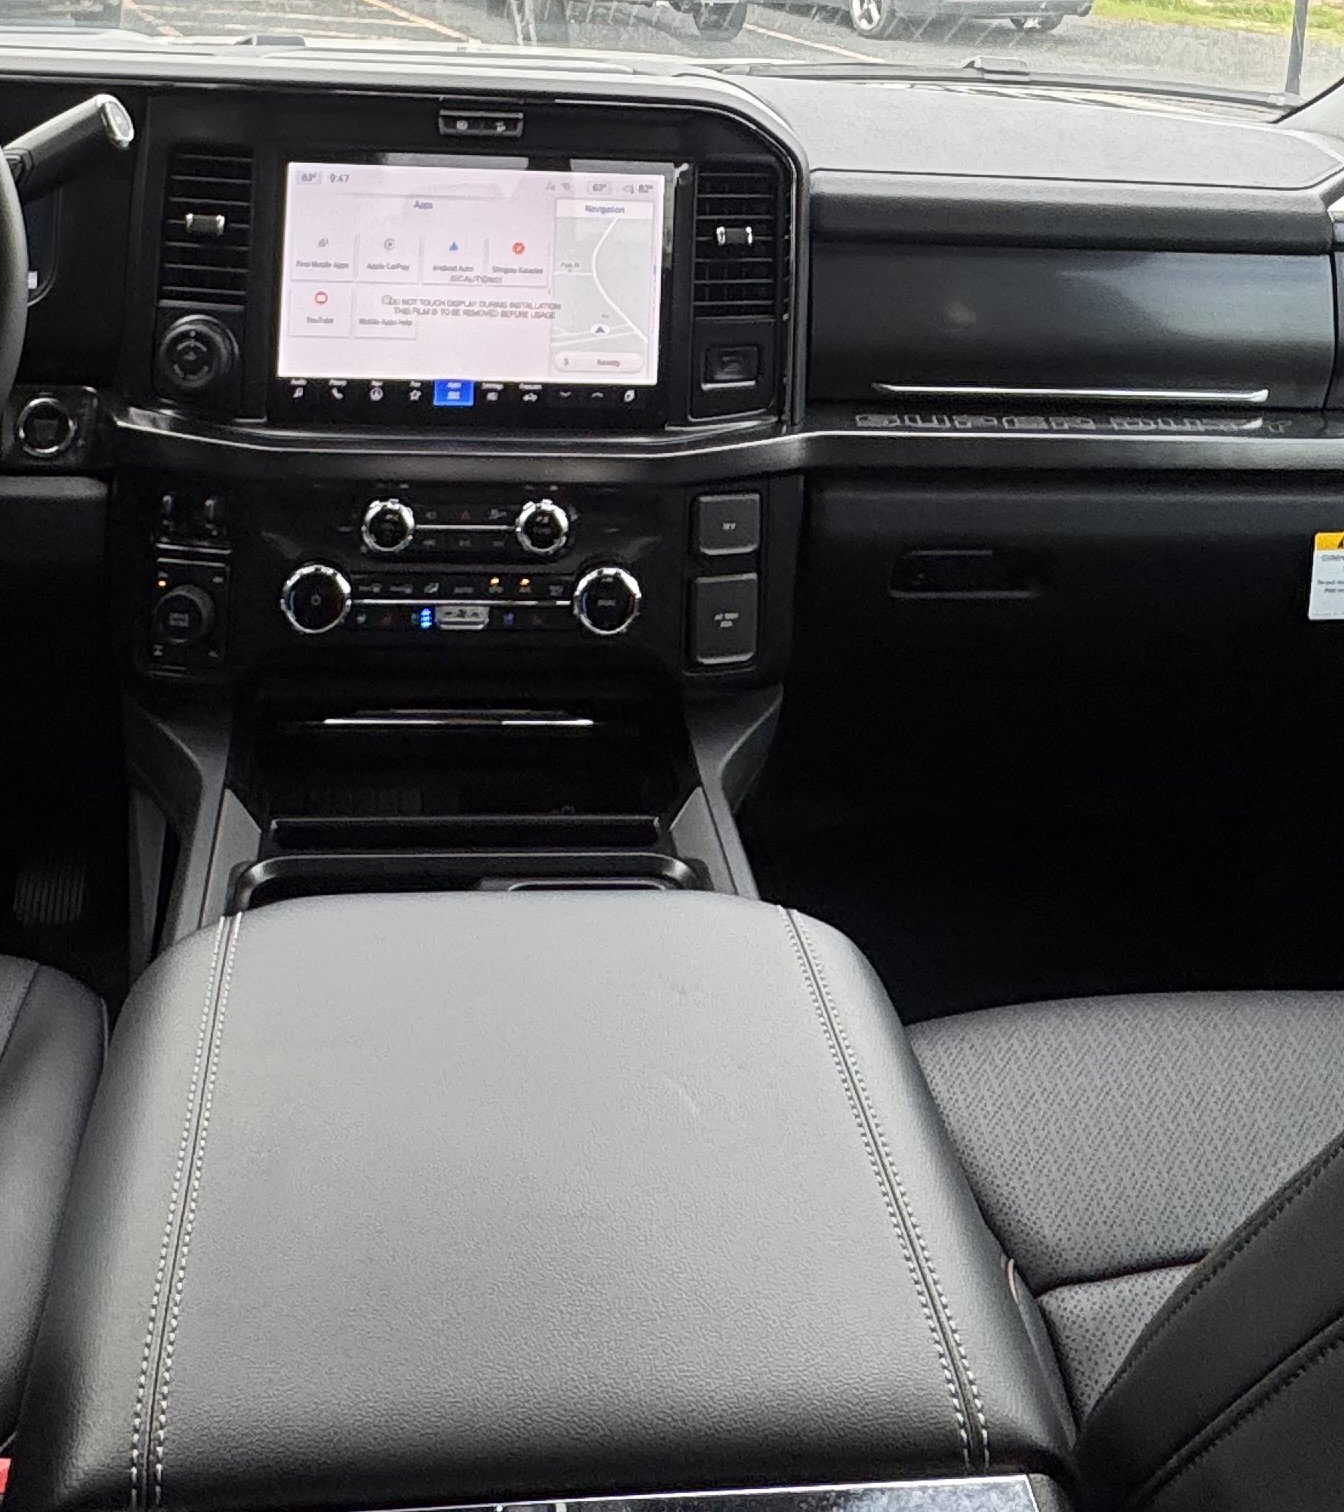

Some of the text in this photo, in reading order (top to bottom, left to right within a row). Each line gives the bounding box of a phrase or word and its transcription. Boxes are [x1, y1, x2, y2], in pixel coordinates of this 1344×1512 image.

[584, 205, 625, 214] Navigation
[402, 299, 417, 307] NOT
[420, 299, 446, 307] TOUCH
[447, 300, 478, 308] DISPLAY
[479, 300, 507, 308] DURING
[509, 301, 562, 310] INSTALLATION
[394, 307, 413, 315] THIS
[413, 308, 430, 316] FILM
[463, 310, 499, 318] REMOVED
[501, 311, 529, 319] BEFORE
[530, 311, 556, 319] USAGE
